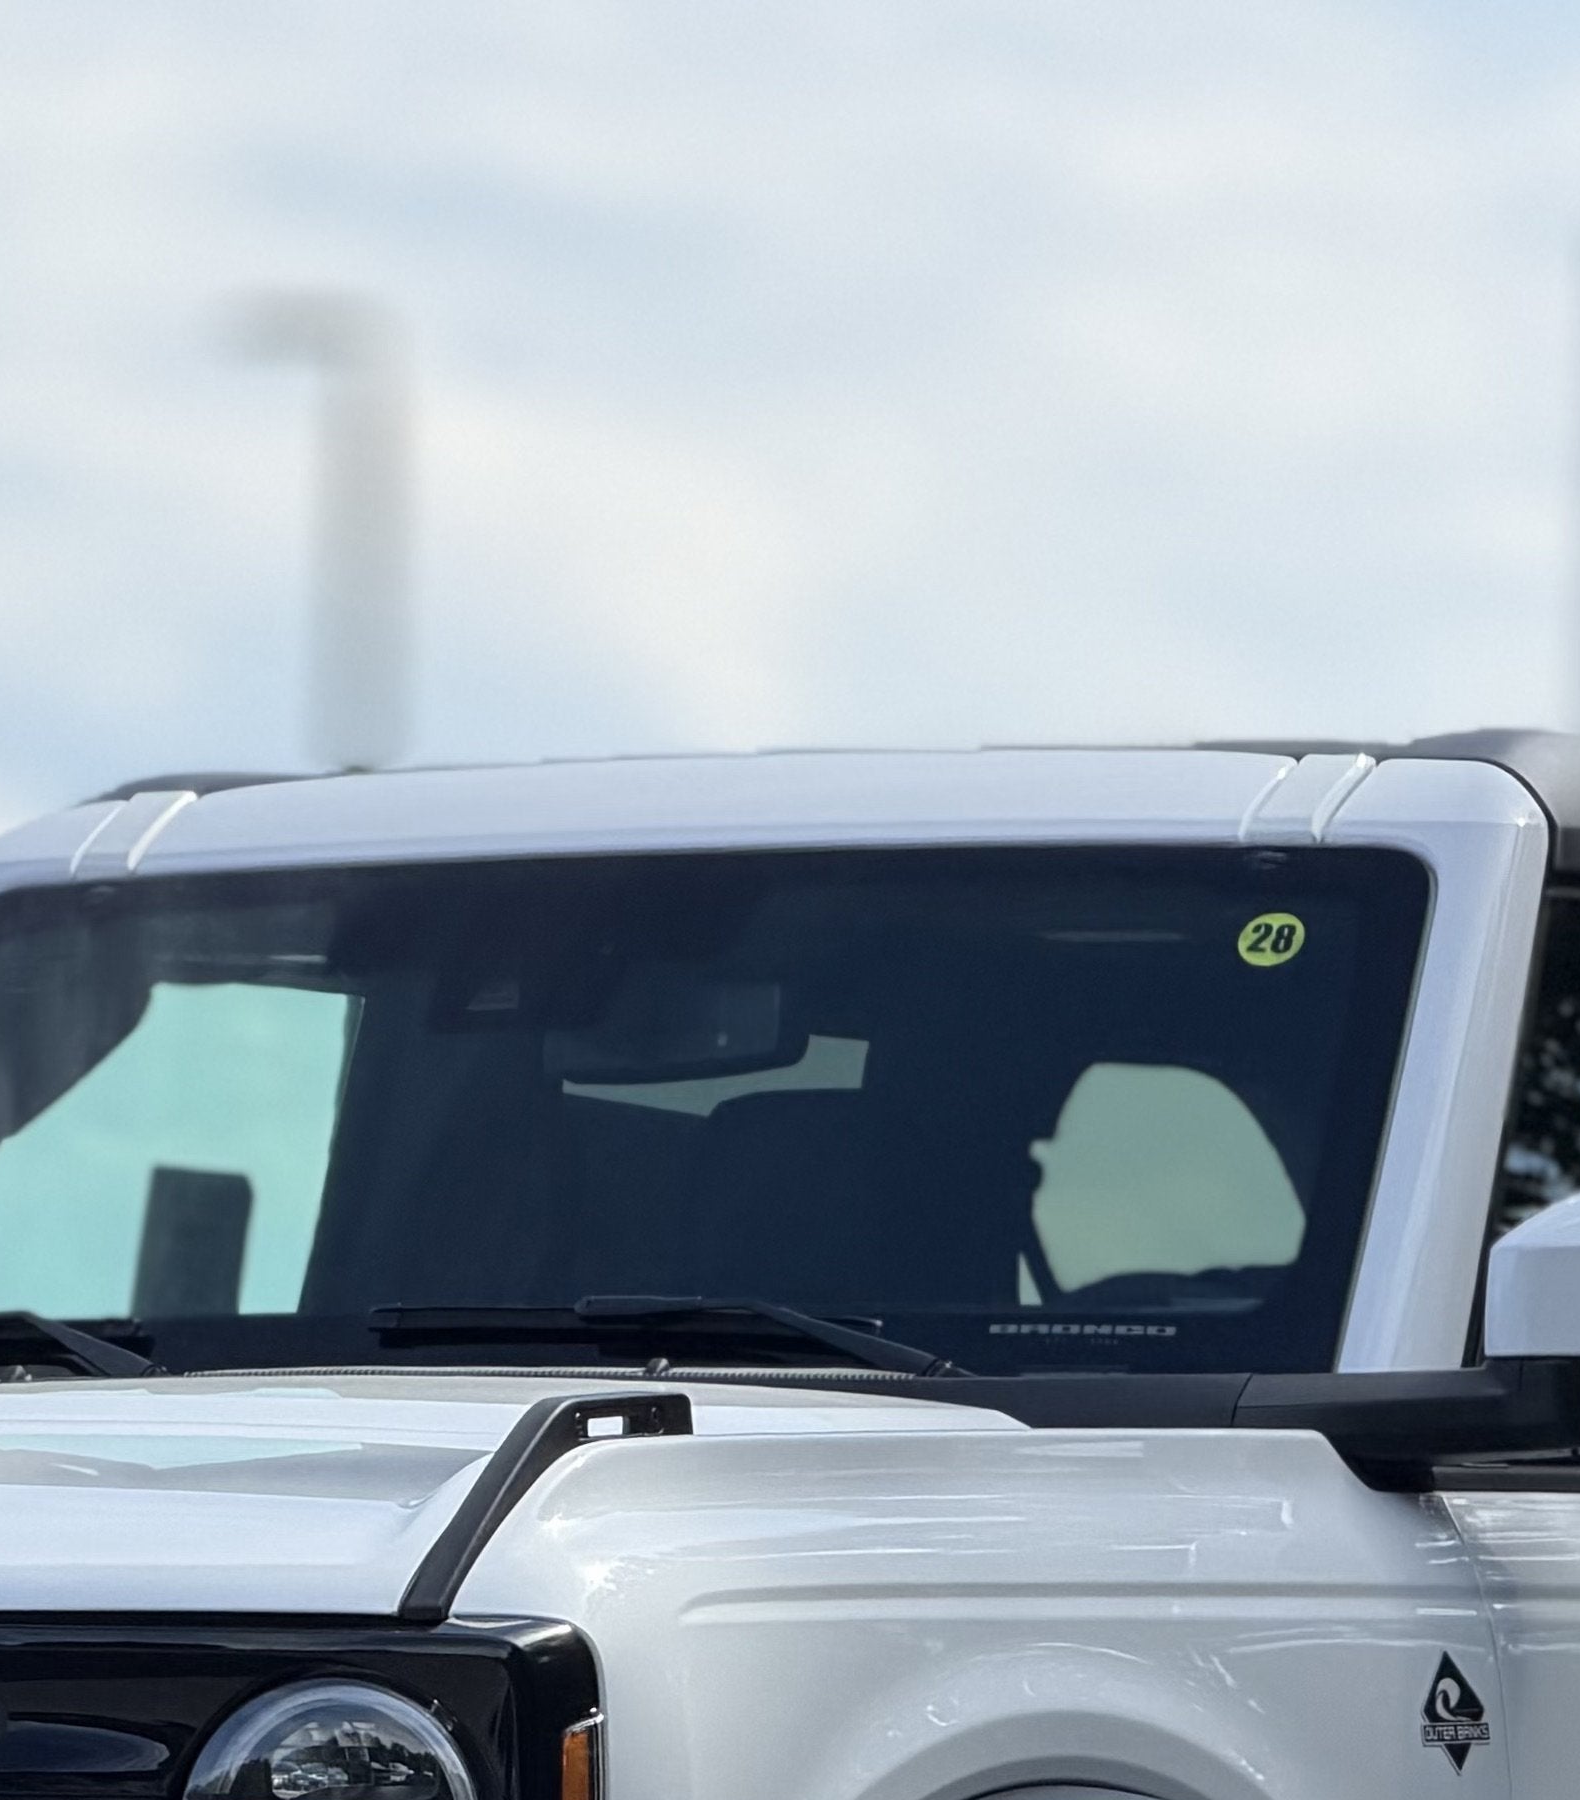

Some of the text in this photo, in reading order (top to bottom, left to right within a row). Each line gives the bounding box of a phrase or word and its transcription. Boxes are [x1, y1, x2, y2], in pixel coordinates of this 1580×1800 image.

[1246, 922, 1297, 954] 28
[989, 1323, 1177, 1336] BRONCO
[1424, 1724, 1489, 1740] OUTER BANKS
